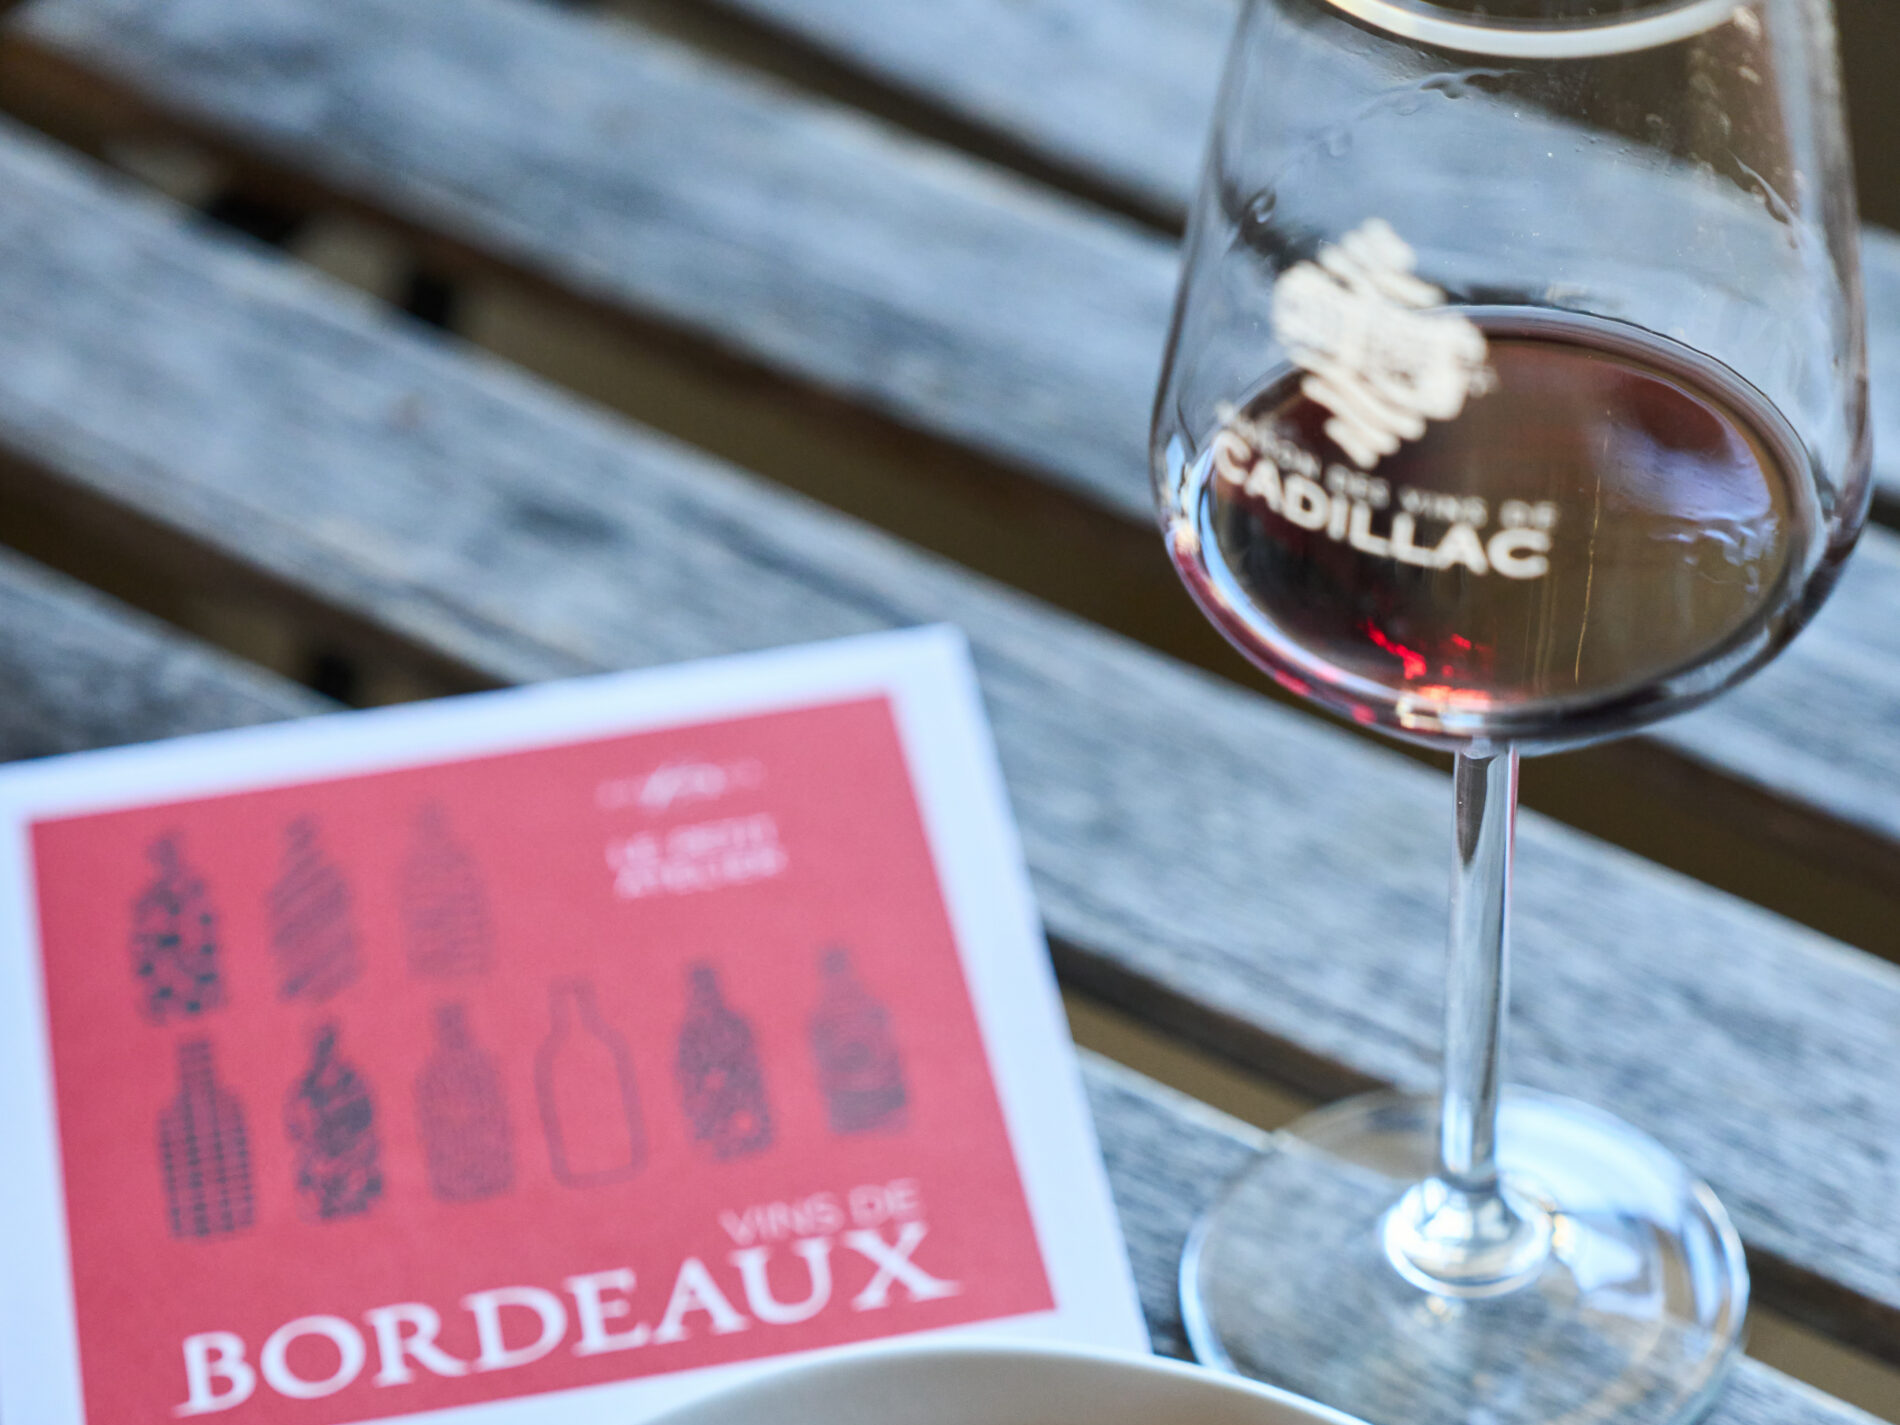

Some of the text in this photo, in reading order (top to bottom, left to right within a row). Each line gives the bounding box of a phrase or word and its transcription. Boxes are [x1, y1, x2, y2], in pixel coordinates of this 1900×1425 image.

[1214, 430, 1551, 579] CADILLAC
[718, 1178, 924, 1245] VINS DE
[174, 1221, 959, 1418] BORDEAUX
